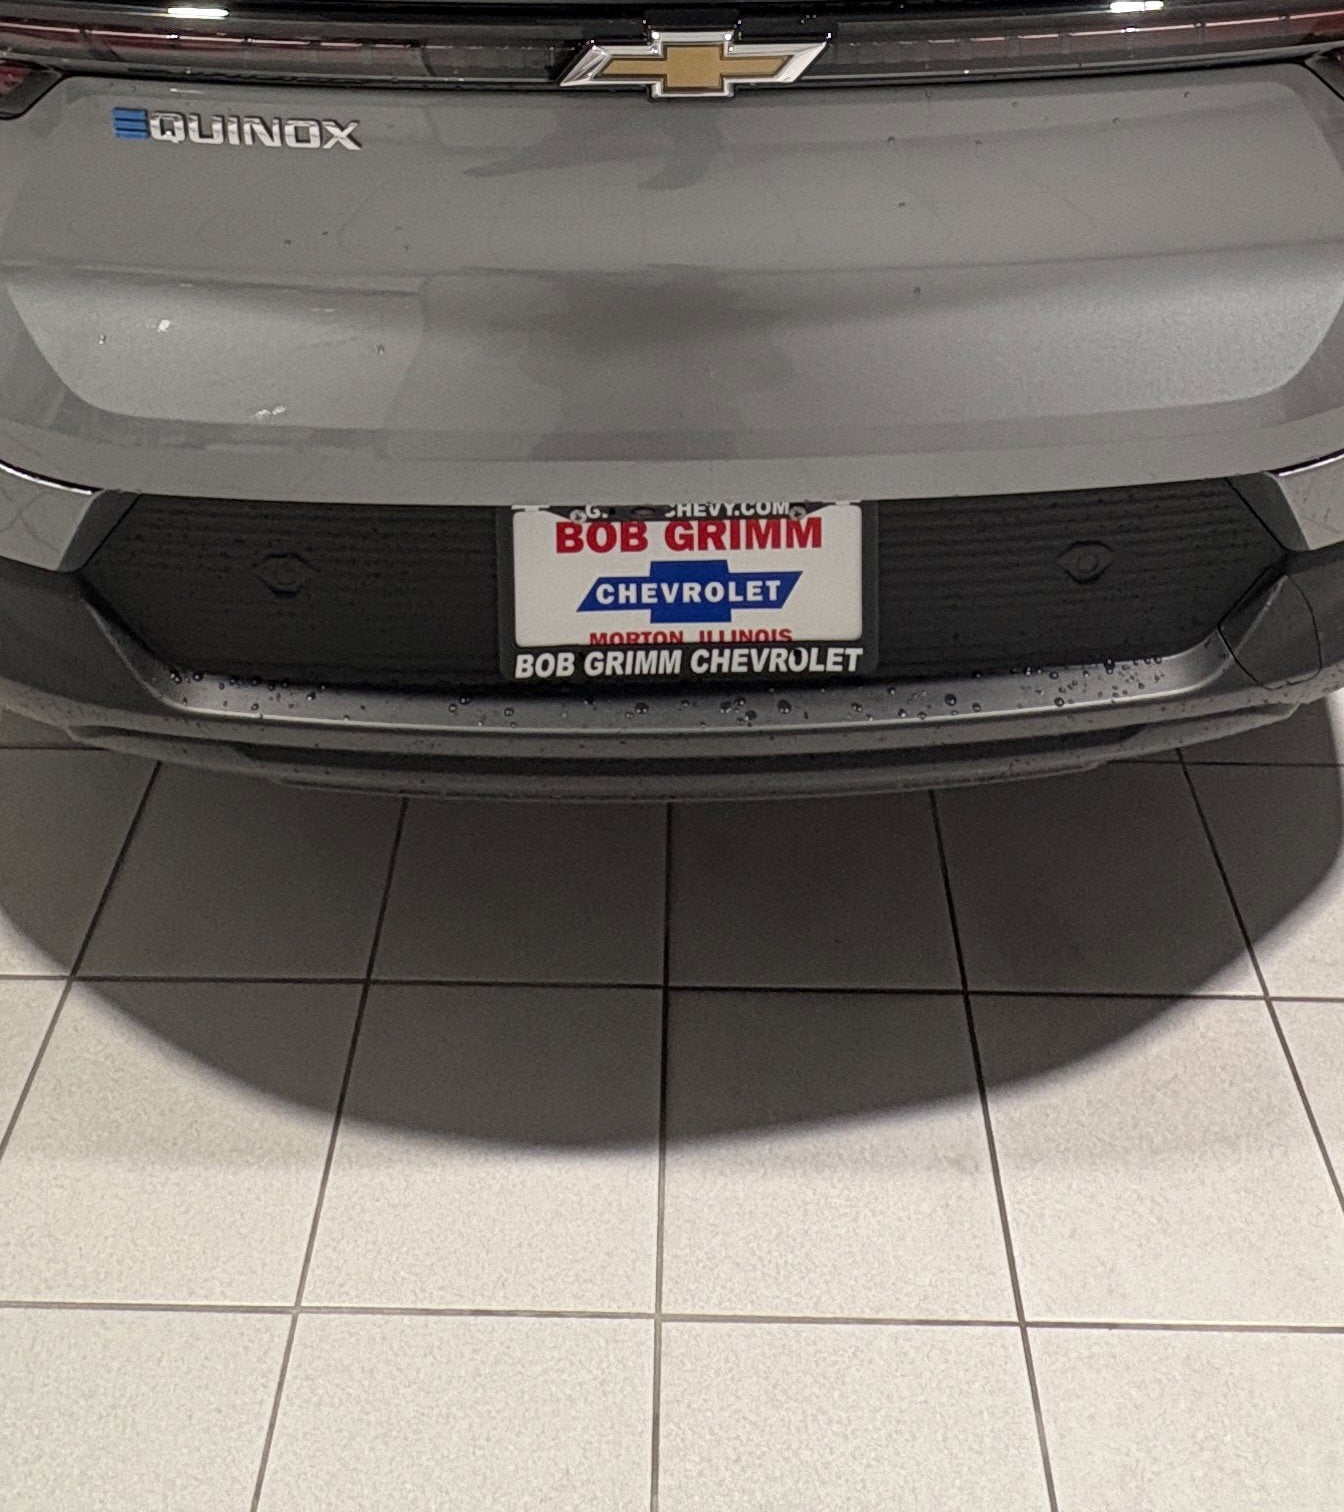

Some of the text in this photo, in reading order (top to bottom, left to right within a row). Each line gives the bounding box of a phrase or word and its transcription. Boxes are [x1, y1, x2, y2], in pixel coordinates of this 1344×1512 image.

[112, 107, 362, 150] EQUINOX
[556, 517, 822, 554] BOB GRIMM
[596, 580, 781, 605] CHEVROLET
[515, 646, 864, 679] BOB GRIMM CHEVROLET
